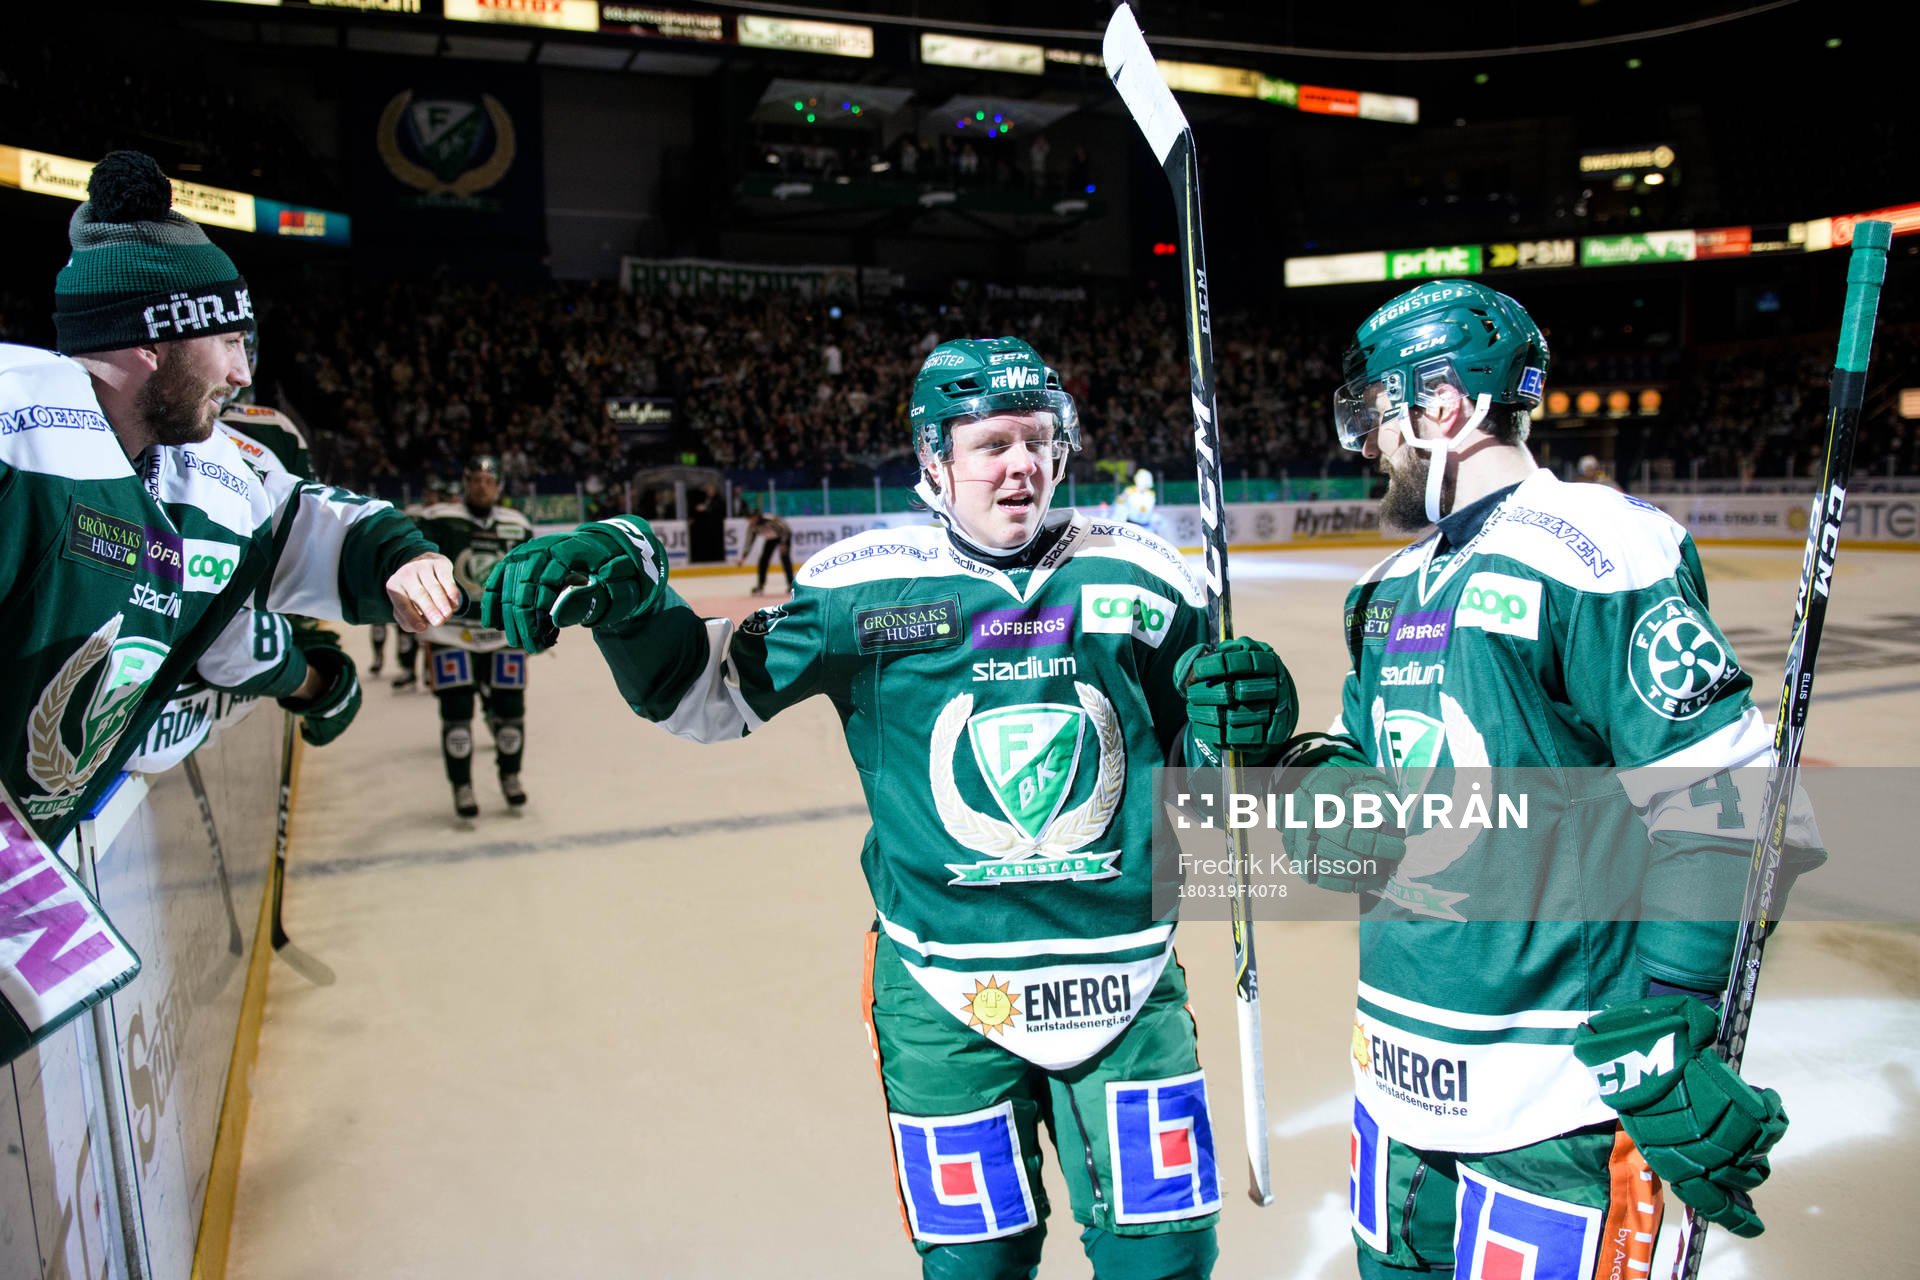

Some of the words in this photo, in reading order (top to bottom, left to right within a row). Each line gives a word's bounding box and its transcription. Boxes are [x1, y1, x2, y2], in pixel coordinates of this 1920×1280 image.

[1393, 247, 1470, 280] print
[1516, 240, 1575, 268] PSM
[1196, 268, 1211, 335] CCM
[1369, 288, 1453, 332] TECHSTEP
[988, 353, 1030, 365] CCM
[1399, 334, 1448, 358] CCM
[991, 366, 1040, 389] KEWAB
[1191, 392, 1222, 598] CCM
[78, 513, 141, 549] GRÖNSAKS
[1042, 523, 1082, 570] stadium
[1815, 480, 1847, 598] CCM
[91, 538, 129, 564] HUSET
[809, 544, 939, 577] MOELVEN
[948, 546, 996, 578] stadium
[863, 607, 948, 631] GRÖNSAKS
[886, 621, 937, 641] HUSET
[979, 616, 1067, 638] LÖFBERGS
[253, 611, 279, 662] 8
[971, 655, 1077, 682] stadium
[1800, 672, 1811, 700] ELLIS
[998, 723, 1034, 780] F
[1688, 767, 1746, 830] 4
[985, 859, 1085, 877] KARLSTAD
[1023, 974, 1131, 1022] ENERGI
[1025, 1013, 1132, 1034] karlstadsenergi.se
[1371, 1034, 1469, 1103] ENERGI
[1375, 1078, 1469, 1117] karlstadsenergi.se
[1614, 1227, 1632, 1247] by
